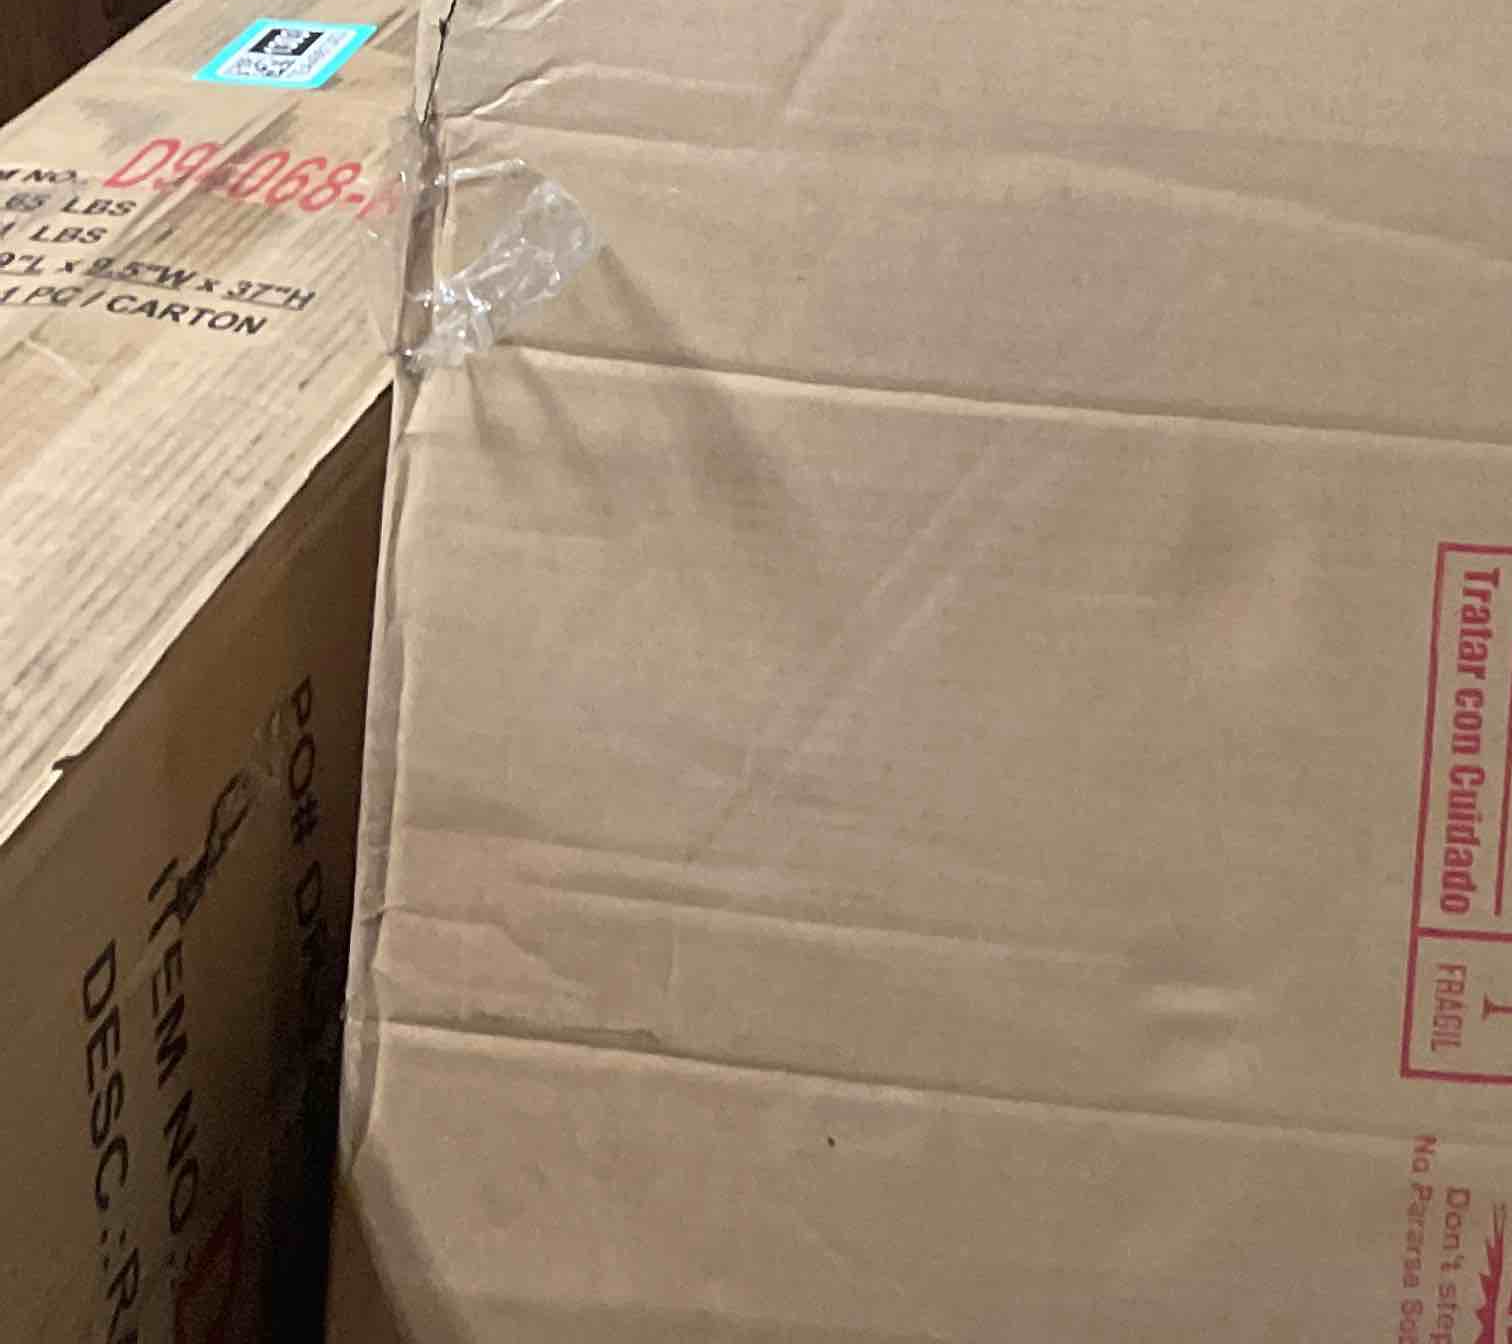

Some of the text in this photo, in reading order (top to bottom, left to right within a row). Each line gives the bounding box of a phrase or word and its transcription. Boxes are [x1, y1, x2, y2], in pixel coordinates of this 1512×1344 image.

[61, 195, 136, 217] LBS
[29, 224, 107, 244] LBS
[107, 293, 268, 336] CARTON
[1440, 567, 1500, 916] Tratar con Cuidado
[1411, 1135, 1440, 1173] No
[1439, 1186, 1471, 1273] Don't
